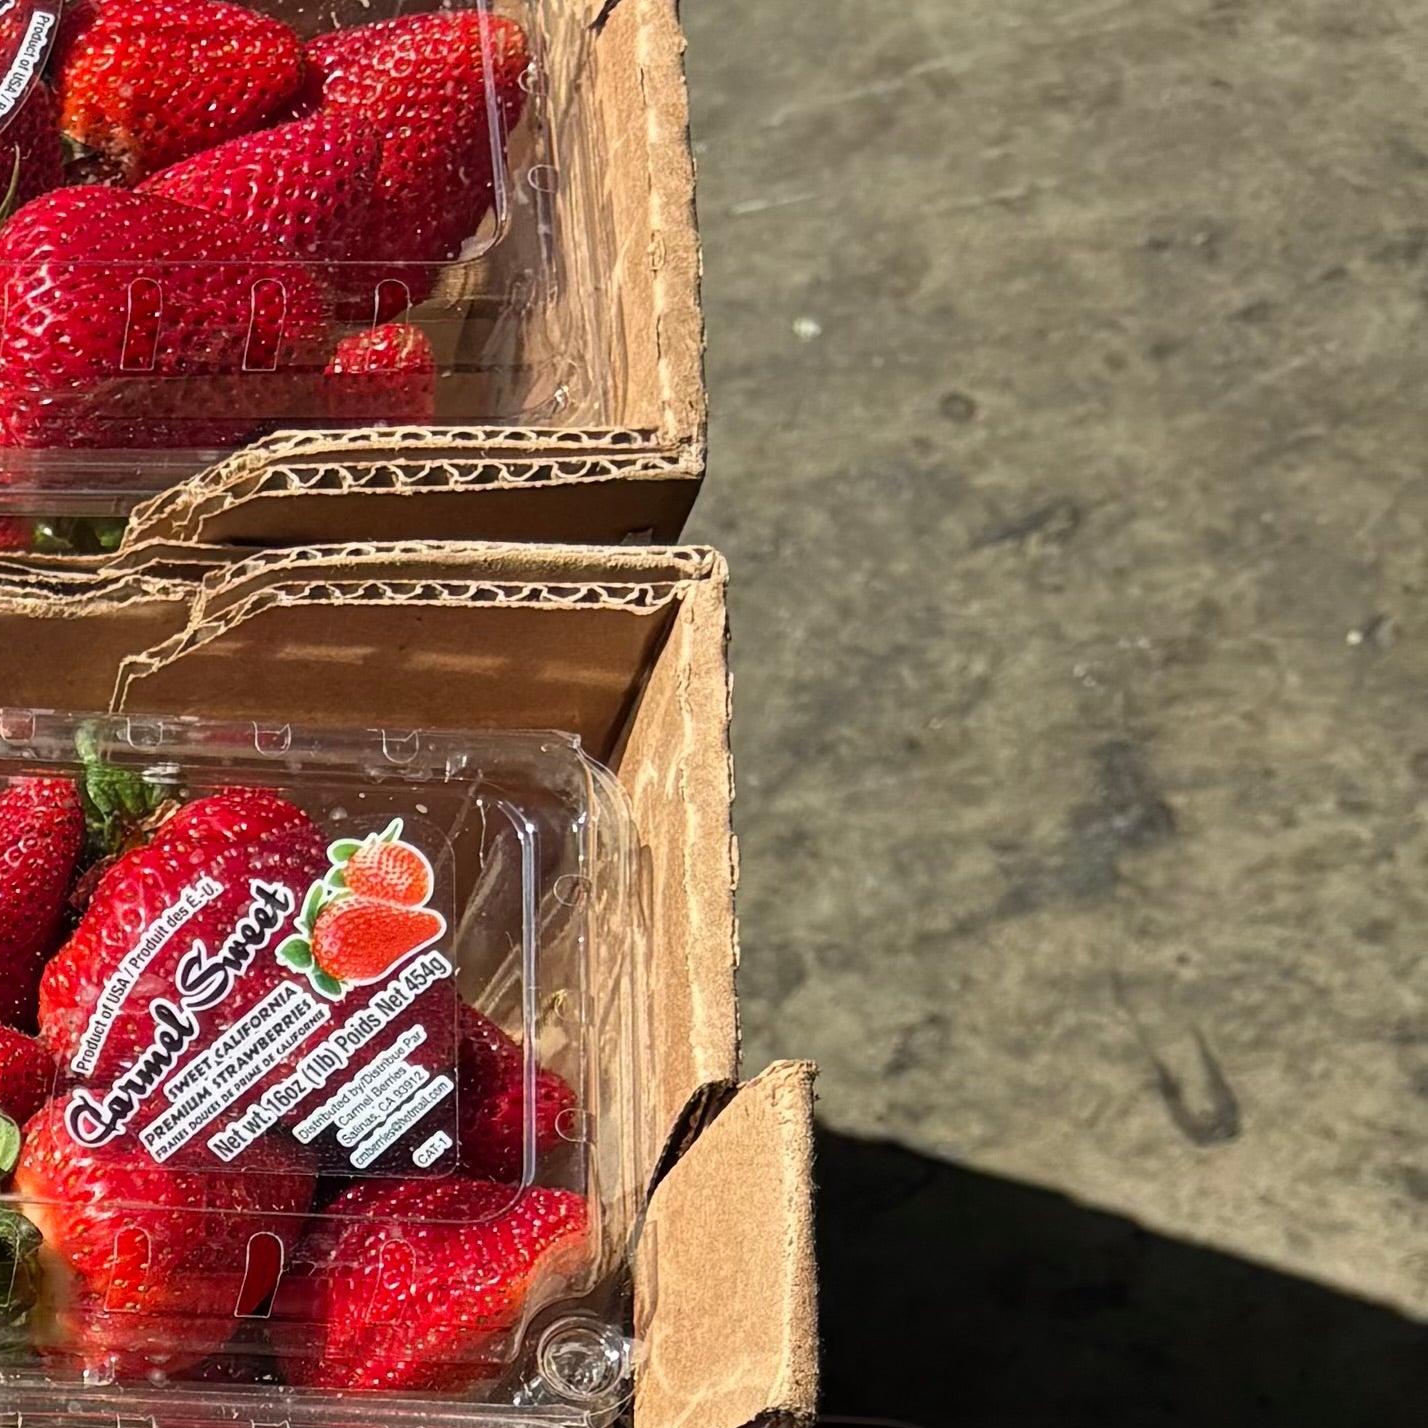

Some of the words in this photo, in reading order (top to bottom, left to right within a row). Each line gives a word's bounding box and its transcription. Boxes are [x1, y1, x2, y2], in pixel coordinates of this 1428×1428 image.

[70, 1002, 196, 1144] Carmel
[180, 884, 289, 1007] Sweet
[143, 1085, 213, 1148] PREMIUM
[211, 997, 312, 1090] STRAWBERRIES
[167, 1055, 213, 1100] SWEET
[214, 985, 298, 1059] CALIFORNIA
[212, 1127, 249, 1159] Net
[240, 1110, 273, 1135] wt.
[264, 1077, 308, 1113] 16oz
[300, 1046, 344, 1086] (1lb)
[332, 1012, 382, 1054] Poids
[373, 986, 410, 1019] Net
[403, 956, 448, 993] 454g
